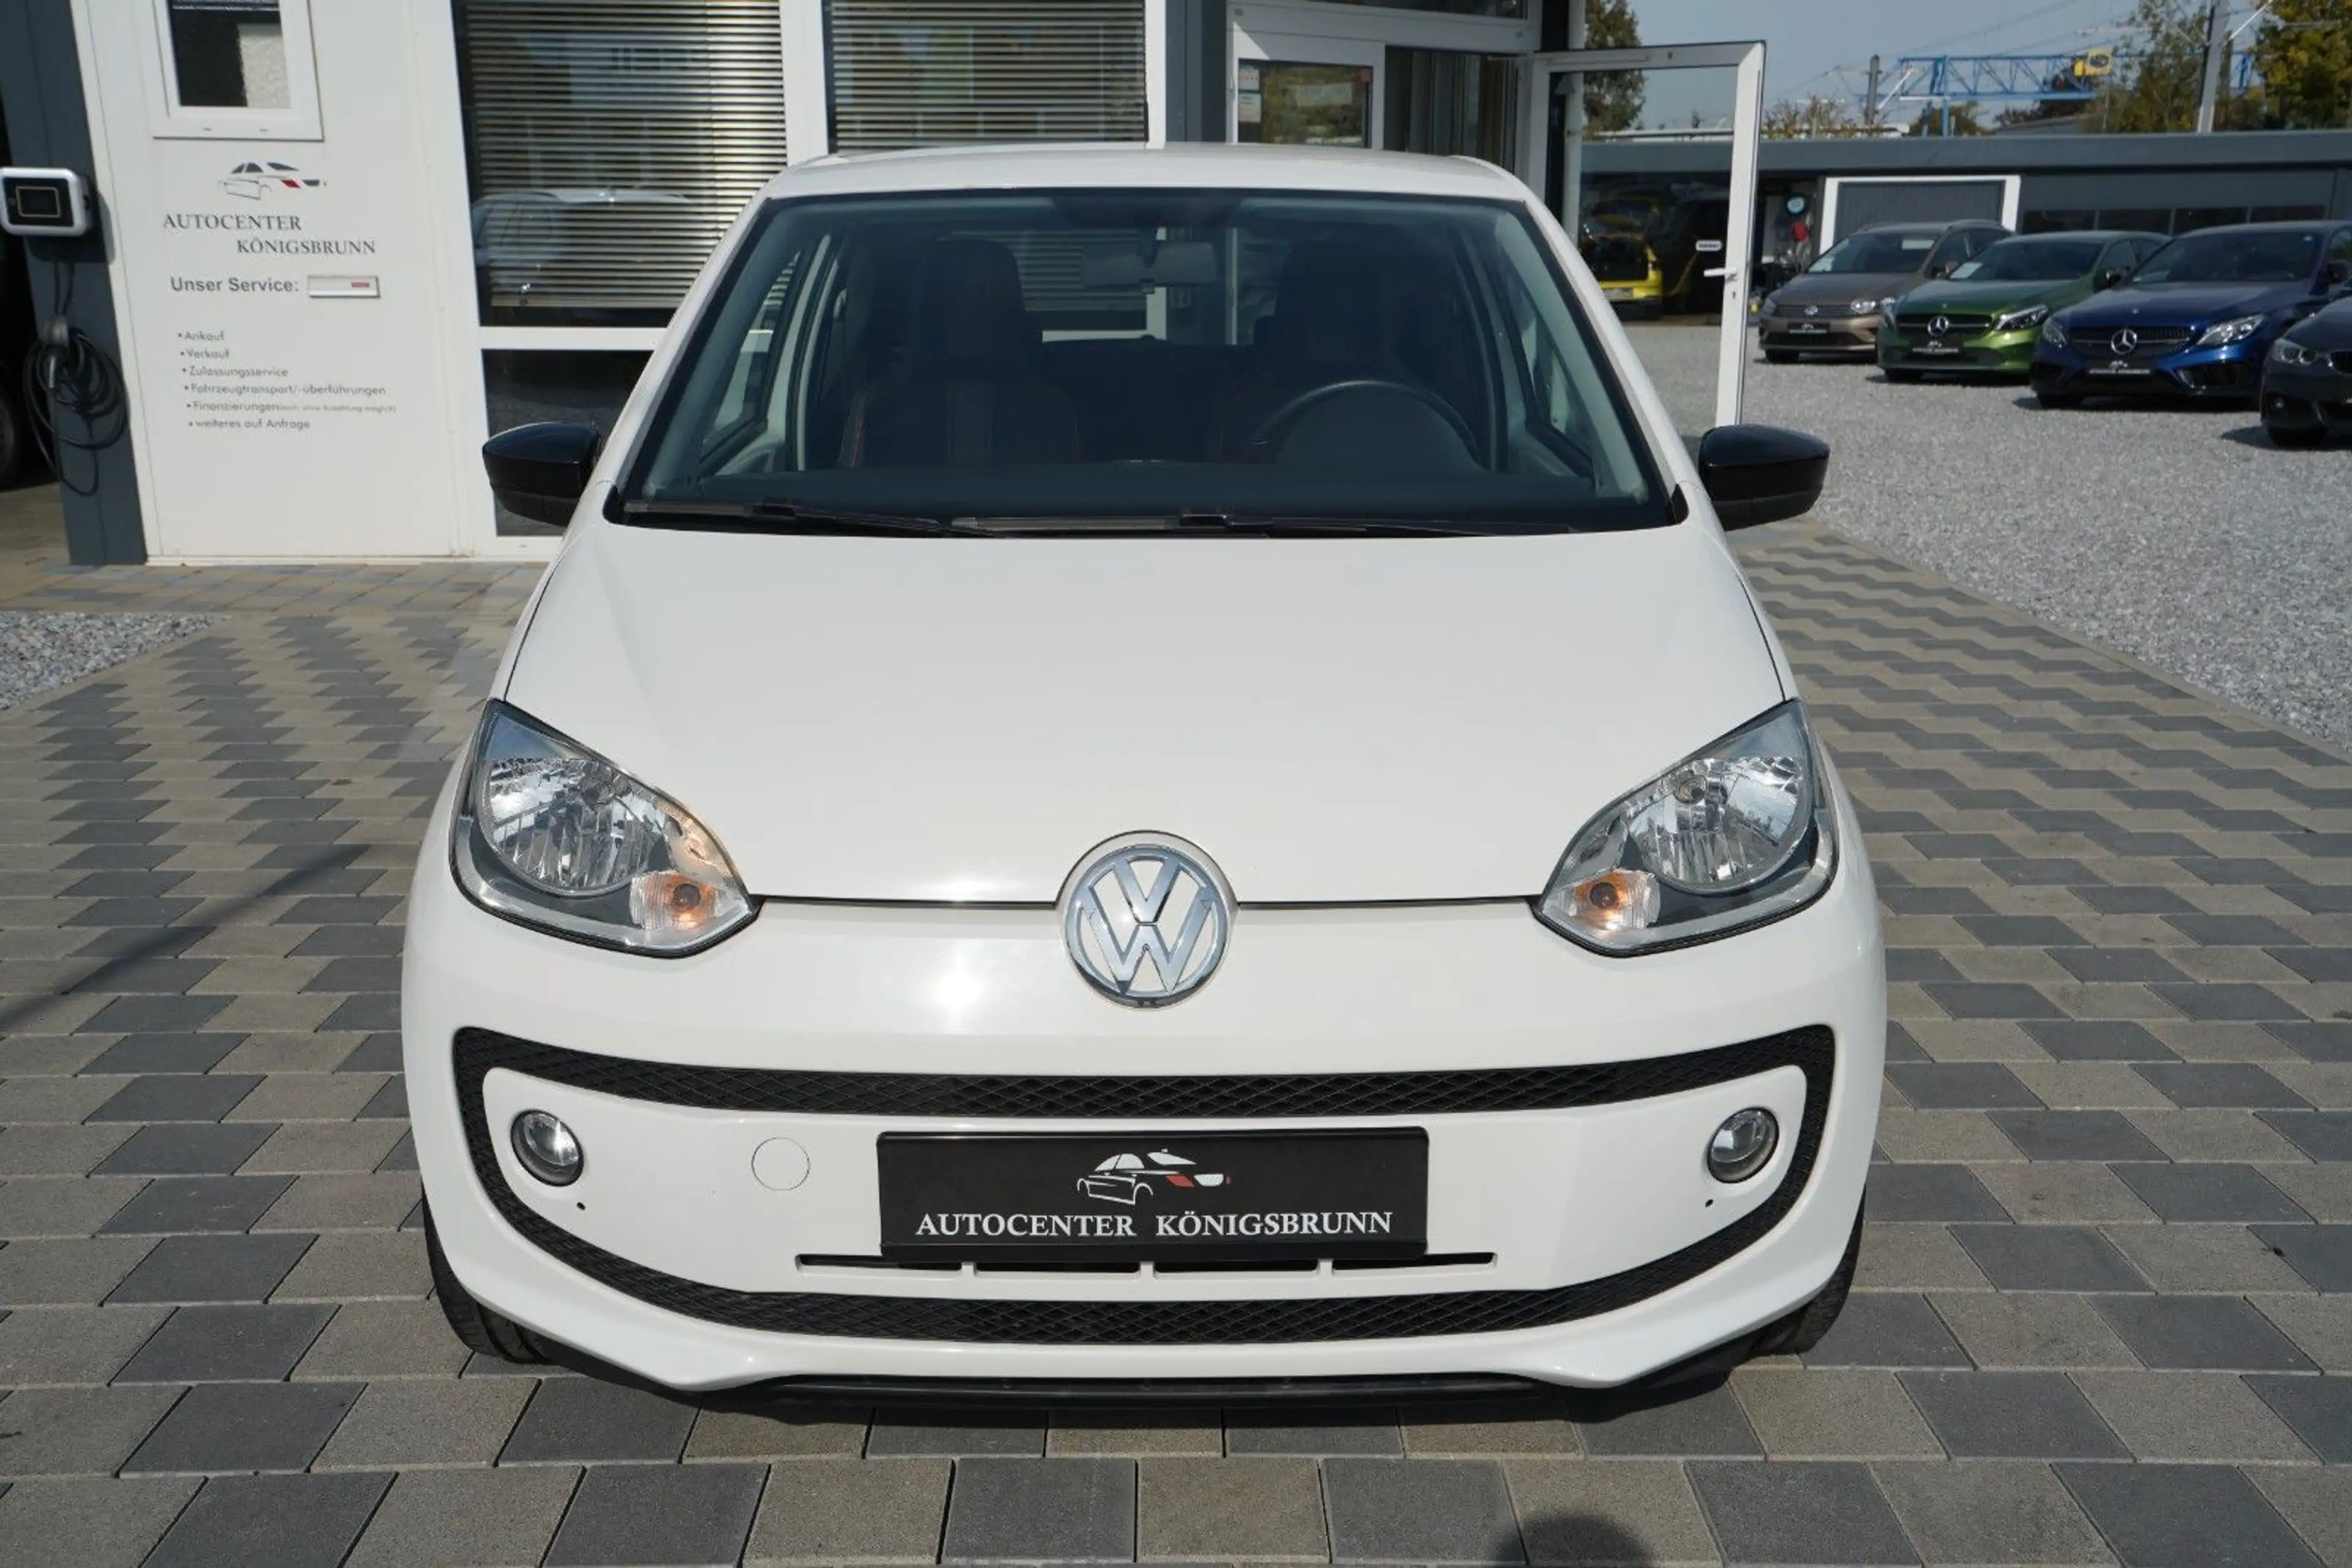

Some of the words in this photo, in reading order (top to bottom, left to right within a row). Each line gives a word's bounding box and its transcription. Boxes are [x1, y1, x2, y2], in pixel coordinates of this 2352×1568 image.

[163, 214, 302, 231] AUTOCENTER
[236, 238, 376, 254] KÖNIGSBRUNN
[170, 277, 222, 292] Unser
[228, 277, 300, 293] Service:
[184, 330, 224, 341] Ankauf
[244, 418, 263, 429] auf
[915, 1213, 1137, 1237] AUTOCENTER
[1155, 1210, 1393, 1237] KÖNIGSBRUNN
